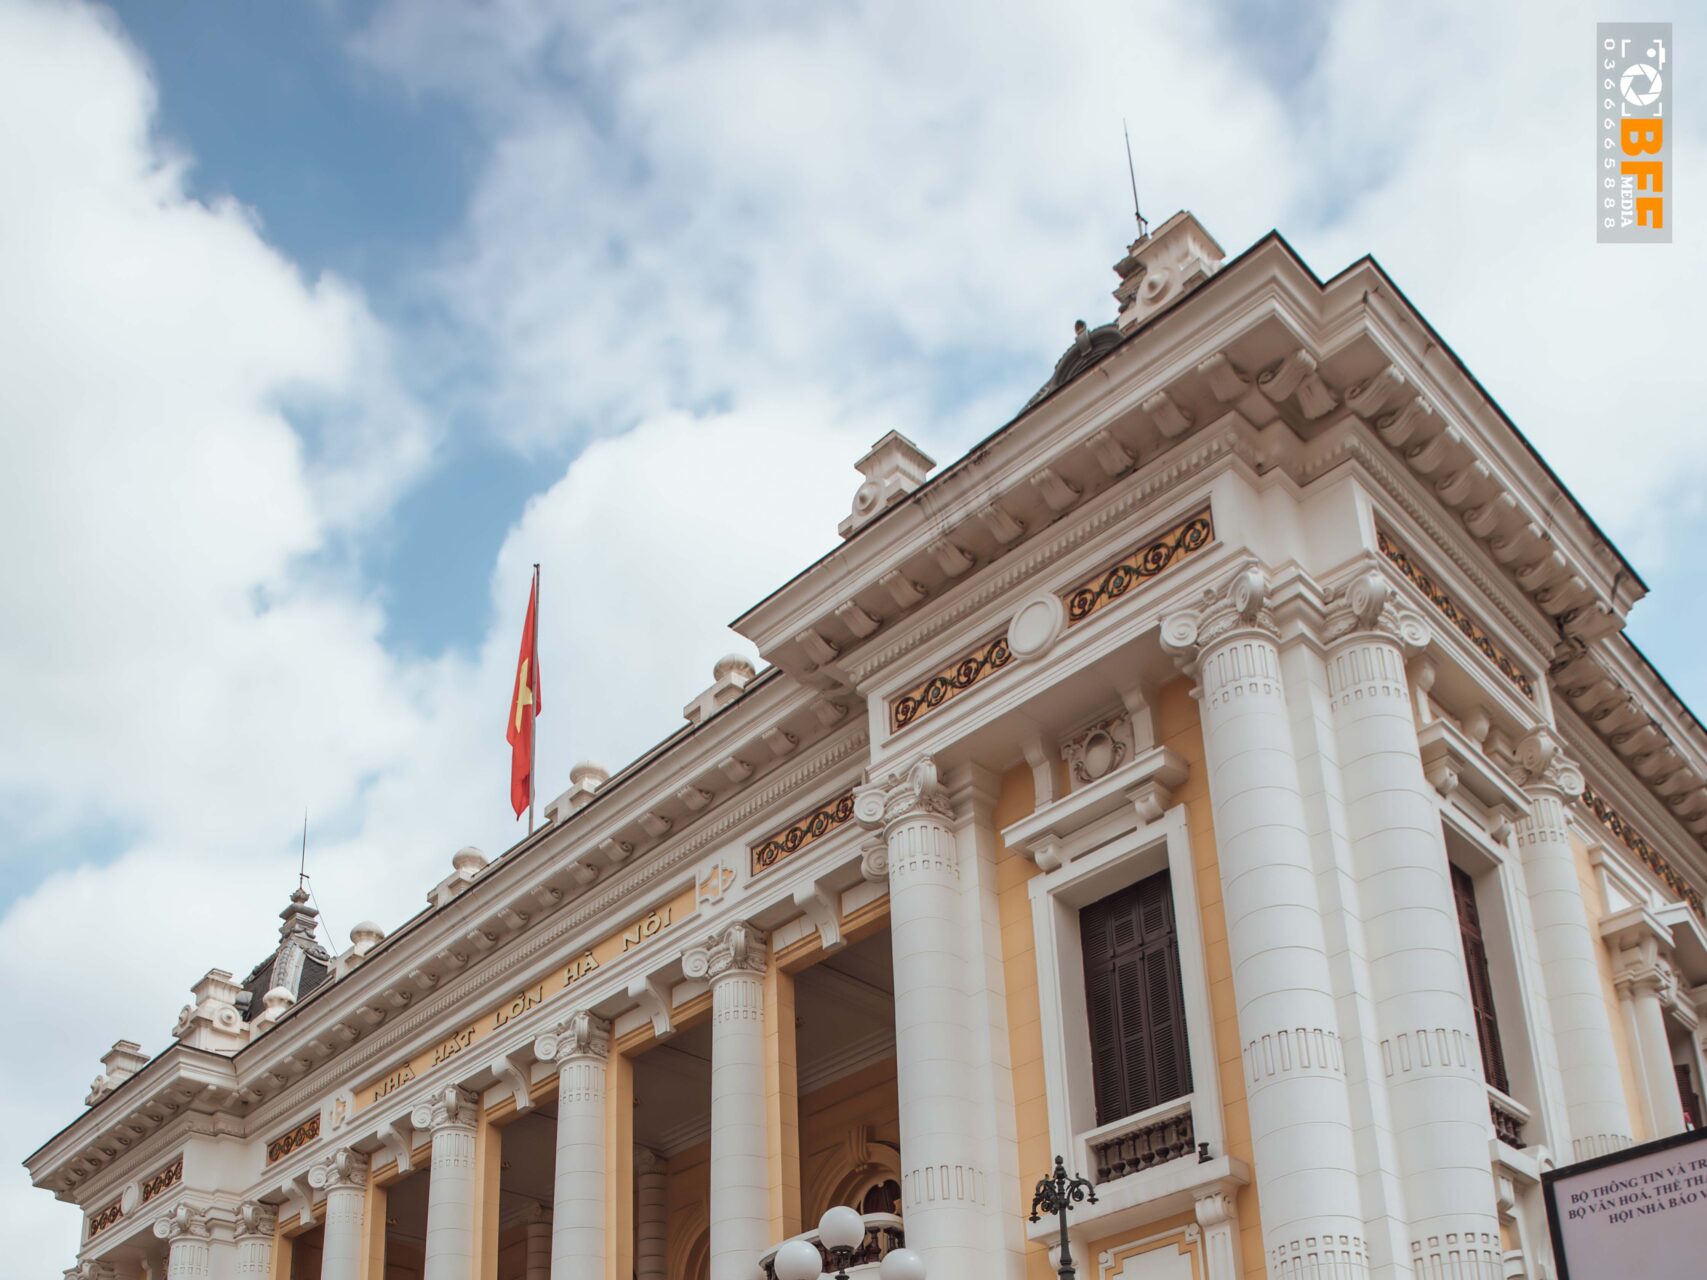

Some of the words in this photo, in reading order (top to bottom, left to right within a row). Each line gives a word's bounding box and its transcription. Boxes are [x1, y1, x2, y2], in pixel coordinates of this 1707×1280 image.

[431, 1026, 476, 1068] HÁT
[1570, 1190, 1589, 1204] BỘ
[1591, 1180, 1639, 1199] THÔNG
[1640, 1171, 1664, 1185] TIN
[1666, 1162, 1687, 1176] VÀ
[1588, 1199, 1616, 1214] VĂN
[1636, 1201, 1666, 1218] NHÀ
[1668, 1192, 1698, 1209] BÁO
